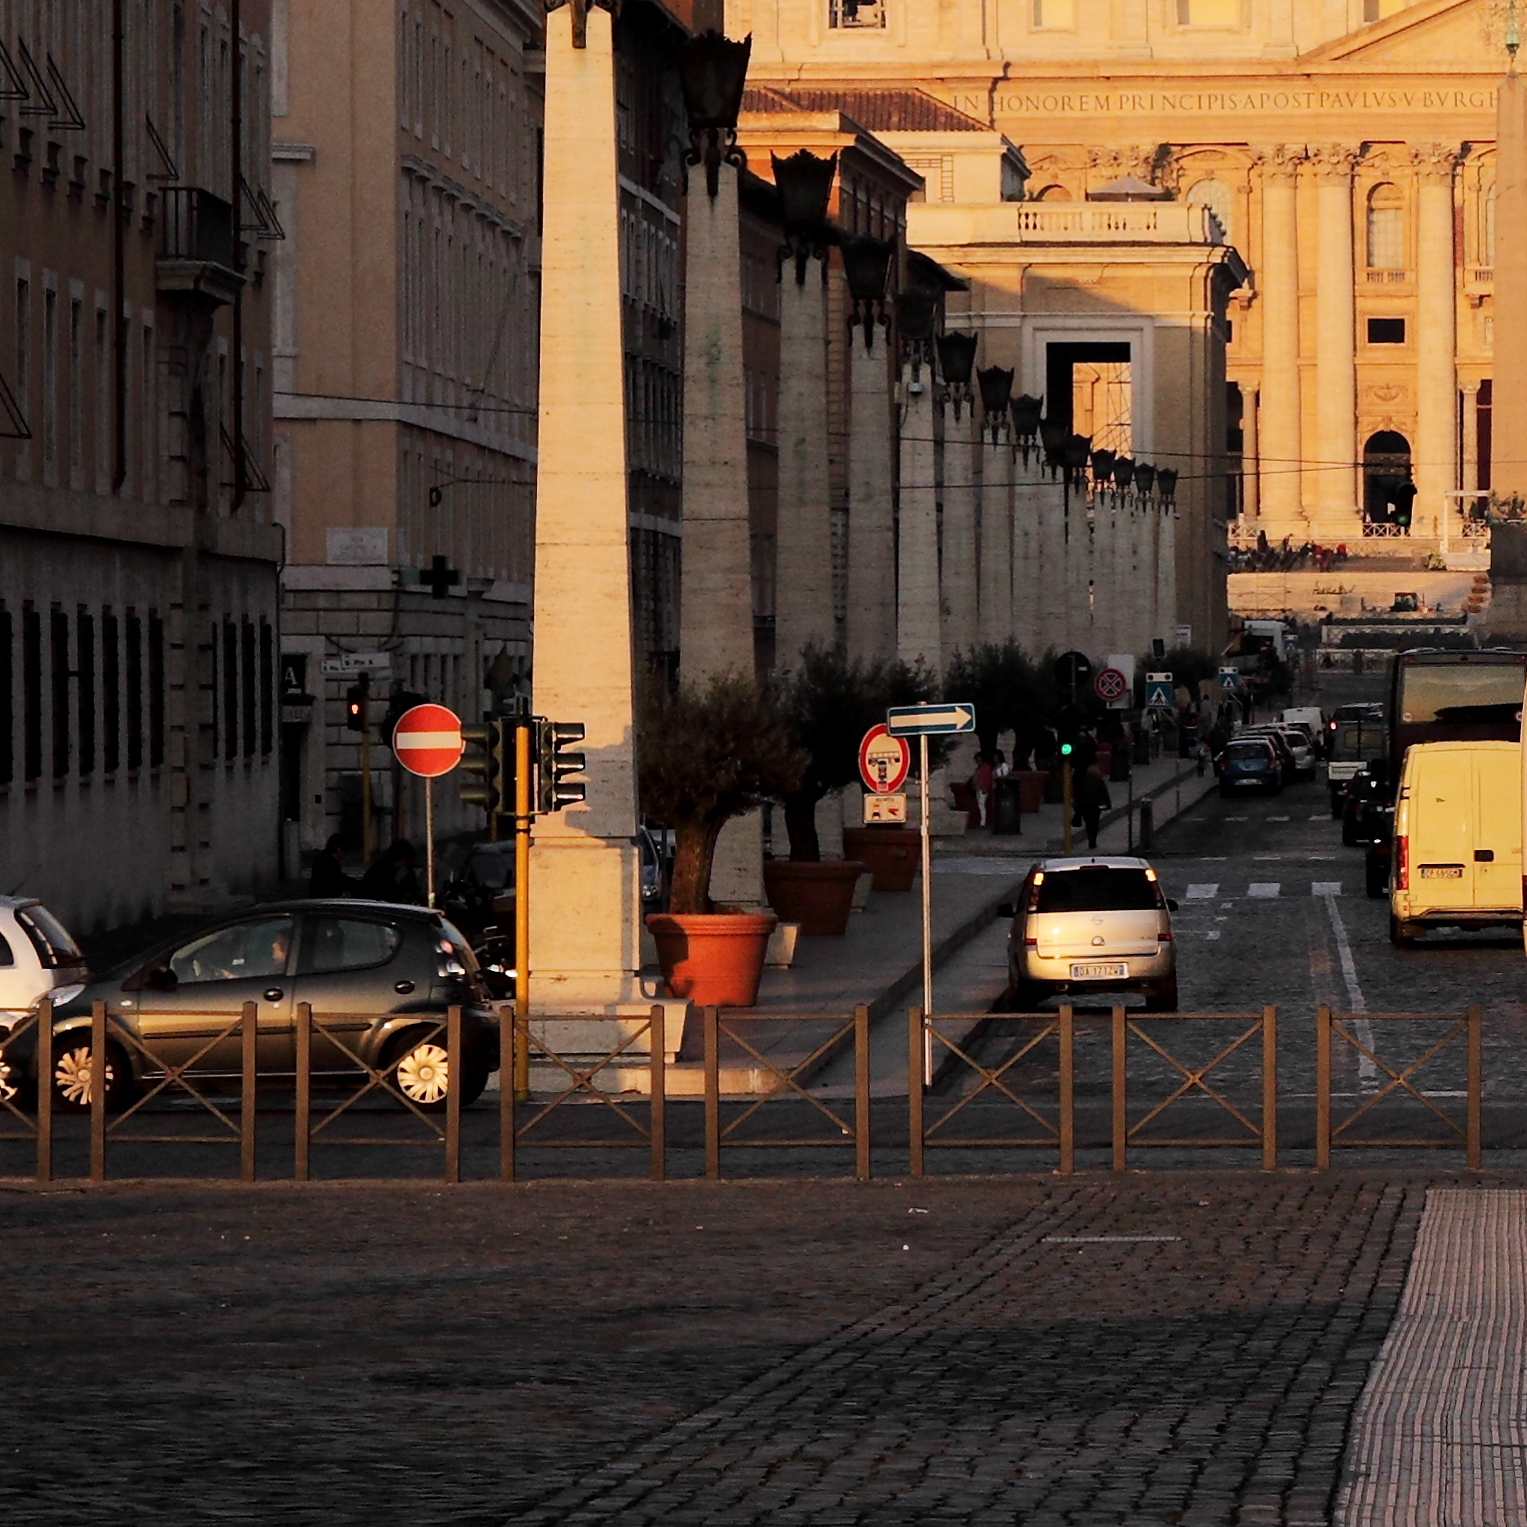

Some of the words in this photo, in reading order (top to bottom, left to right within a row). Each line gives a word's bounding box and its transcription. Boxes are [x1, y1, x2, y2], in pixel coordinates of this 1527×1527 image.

[953, 95, 979, 111] IN
[994, 94, 1111, 112] HONOREM
[1119, 93, 1238, 111] PRINCIPIS
[1243, 92, 1316, 109] APOST
[1320, 91, 1398, 109] PAVLVS
[1400, 91, 1416, 108] V
